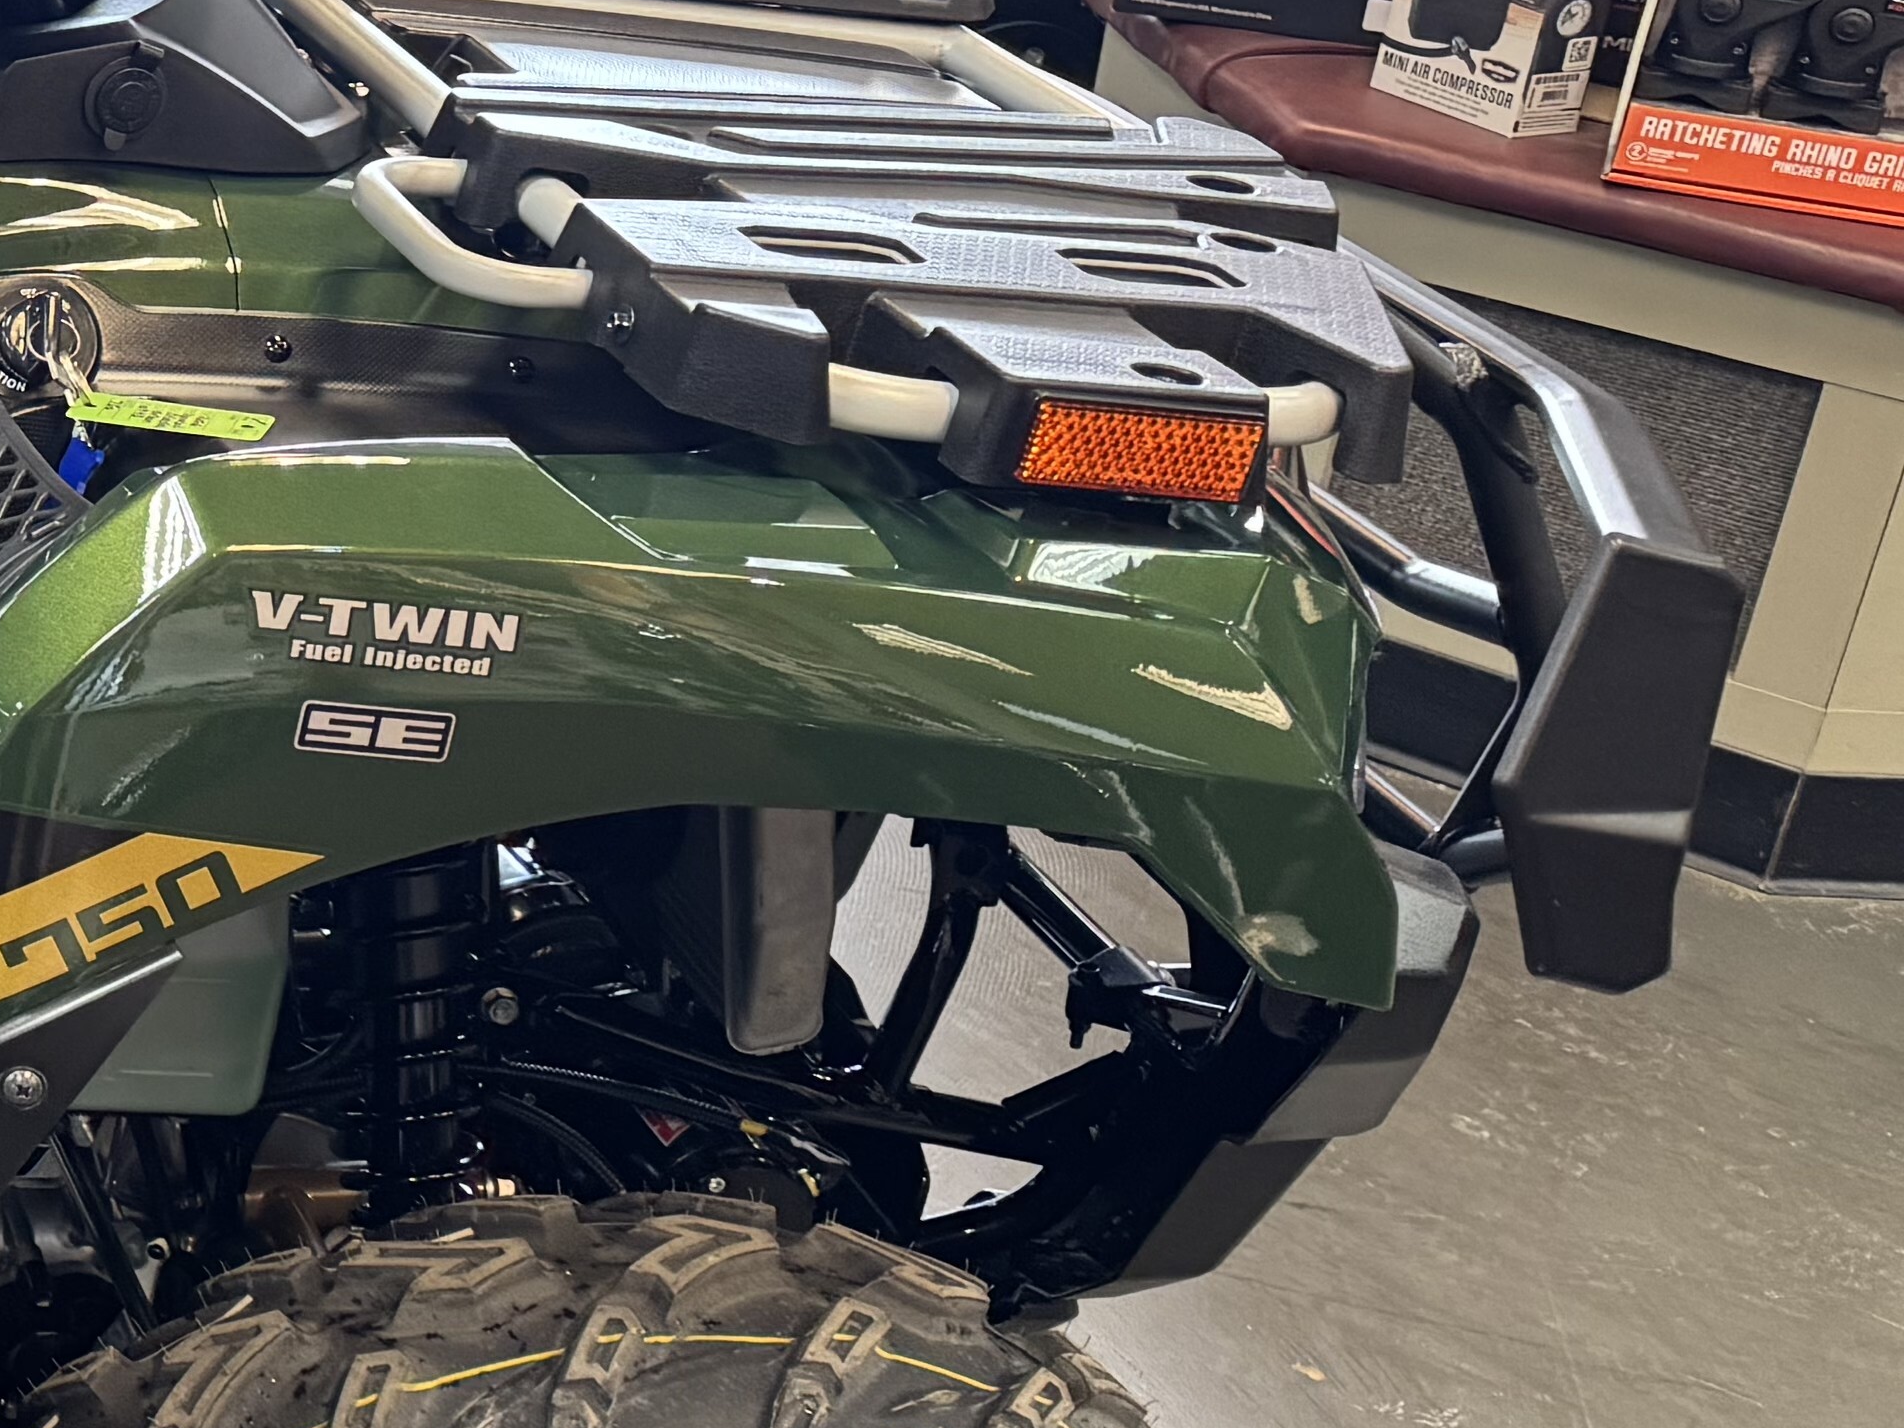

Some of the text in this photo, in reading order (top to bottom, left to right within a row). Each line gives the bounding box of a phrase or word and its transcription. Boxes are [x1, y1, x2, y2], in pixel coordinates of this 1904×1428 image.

[1381, 50, 1515, 110] MINI AIR COMPRESSOR
[1640, 115, 1782, 158] RATCHETING
[1786, 139, 1858, 171] RHINO
[1771, 159, 1823, 179] PINCHES
[1838, 170, 1890, 191] CLIQUET
[249, 589, 521, 653] V-TWIN
[289, 638, 493, 679] Fuel Injected
[304, 708, 446, 754] SE
